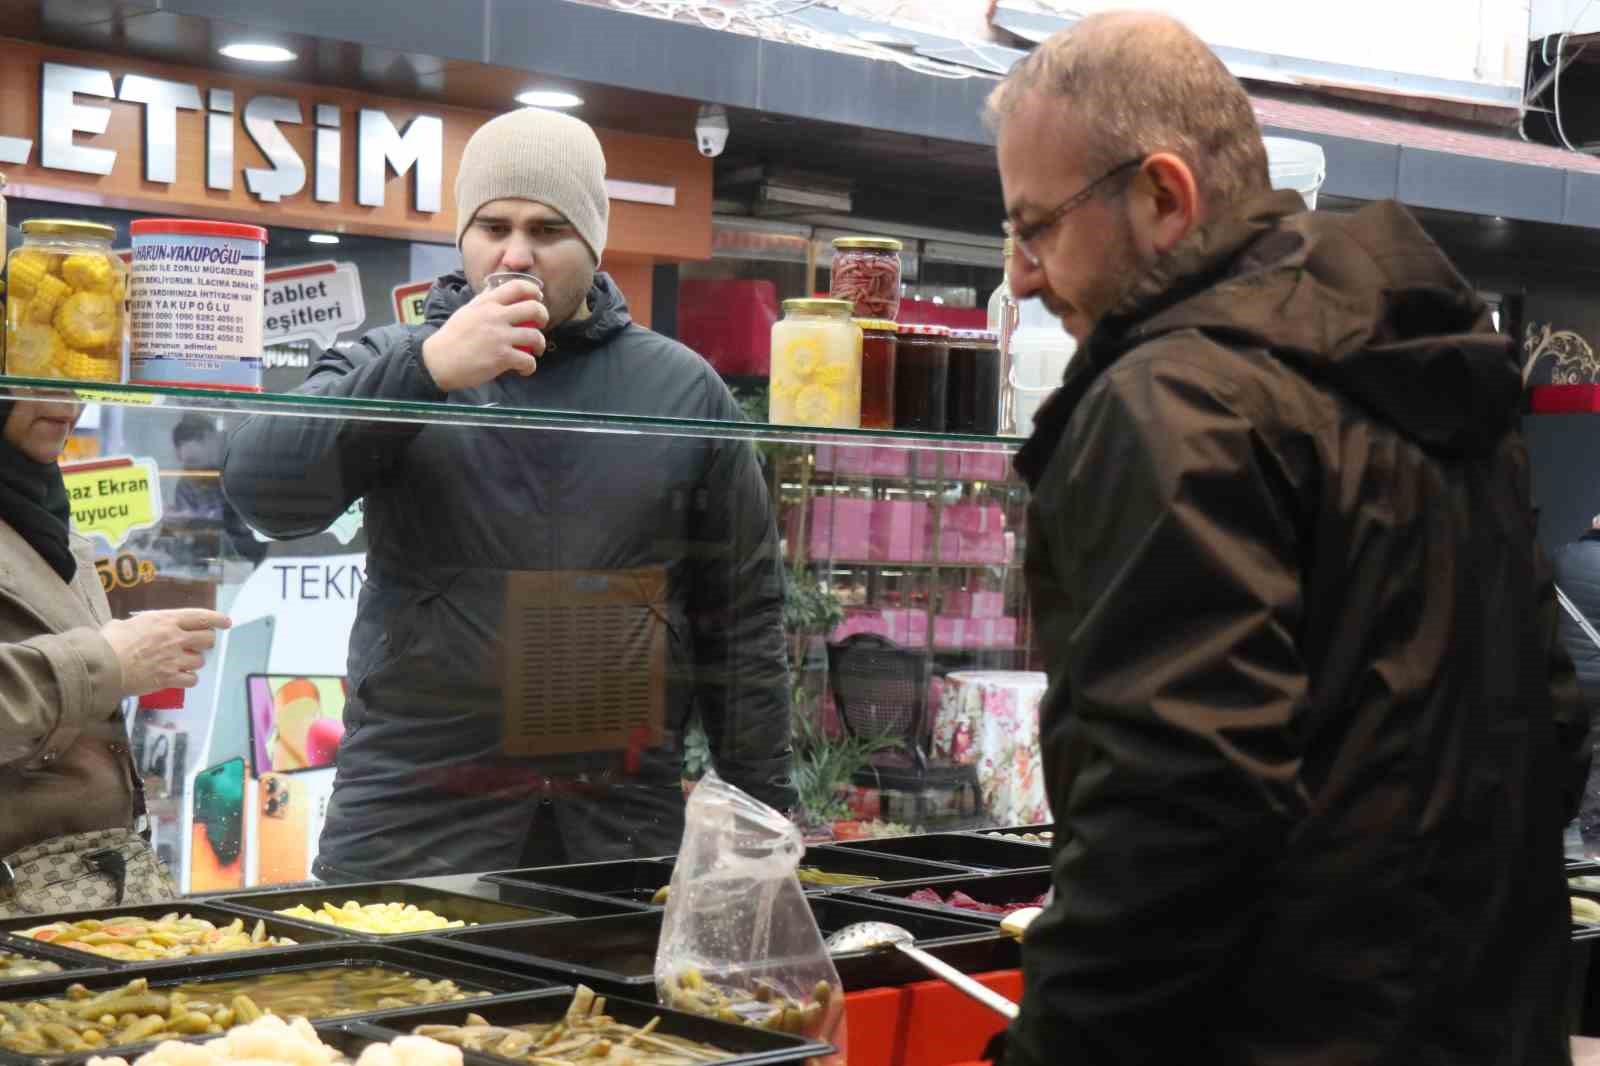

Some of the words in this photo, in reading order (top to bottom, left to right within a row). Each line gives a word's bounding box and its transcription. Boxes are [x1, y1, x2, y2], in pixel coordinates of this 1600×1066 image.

[263, 281, 328, 306] Tablet
[264, 302, 342, 333] eşitleri
[97, 479, 148, 496] Ekran
